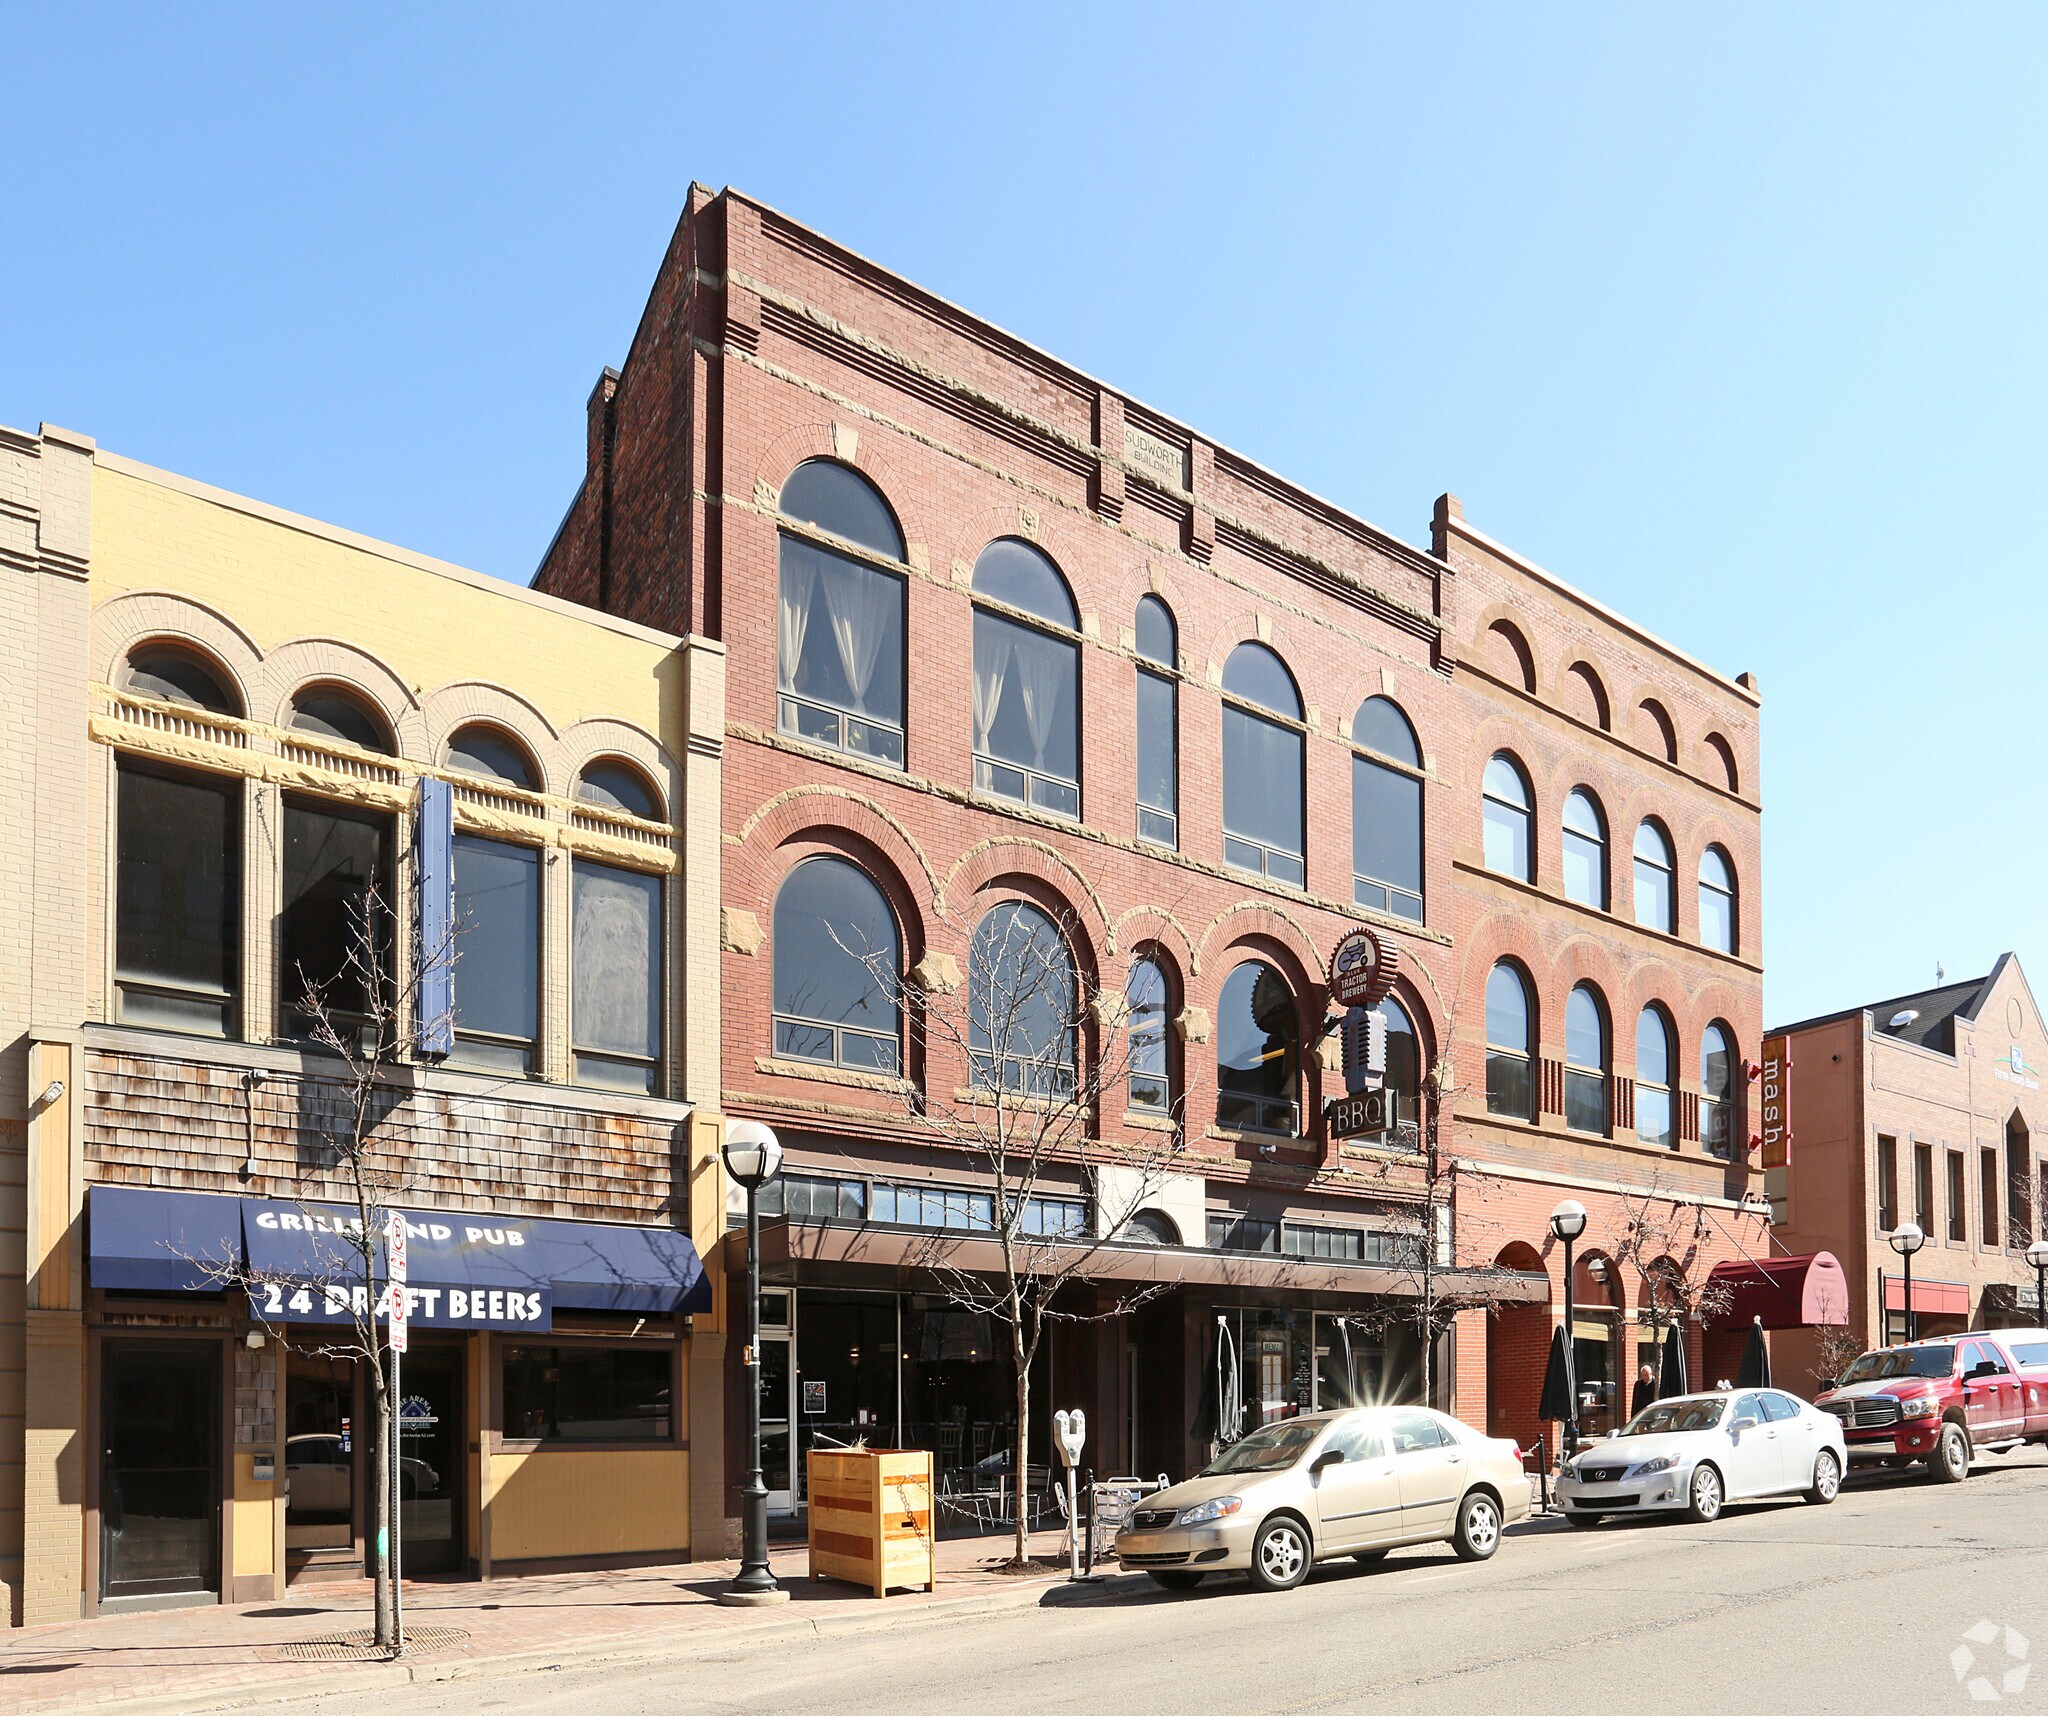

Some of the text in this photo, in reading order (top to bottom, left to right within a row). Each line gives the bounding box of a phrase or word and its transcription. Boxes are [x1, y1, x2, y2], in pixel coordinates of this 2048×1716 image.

[1125, 430, 1182, 469] SUDWORTH
[1341, 972, 1367, 989] TRACTOR
[1341, 983, 1367, 1000] BREWERY
[1337, 1096, 1382, 1132] BBQ
[1764, 1058, 1784, 1146] mash
[382, 1219, 452, 1241] ND
[465, 1226, 525, 1246] PUB
[264, 1283, 313, 1315] 24
[449, 1289, 543, 1321] BEERS
[1264, 1343, 1279, 1351] MENU
[409, 1395, 431, 1411] ARENA
